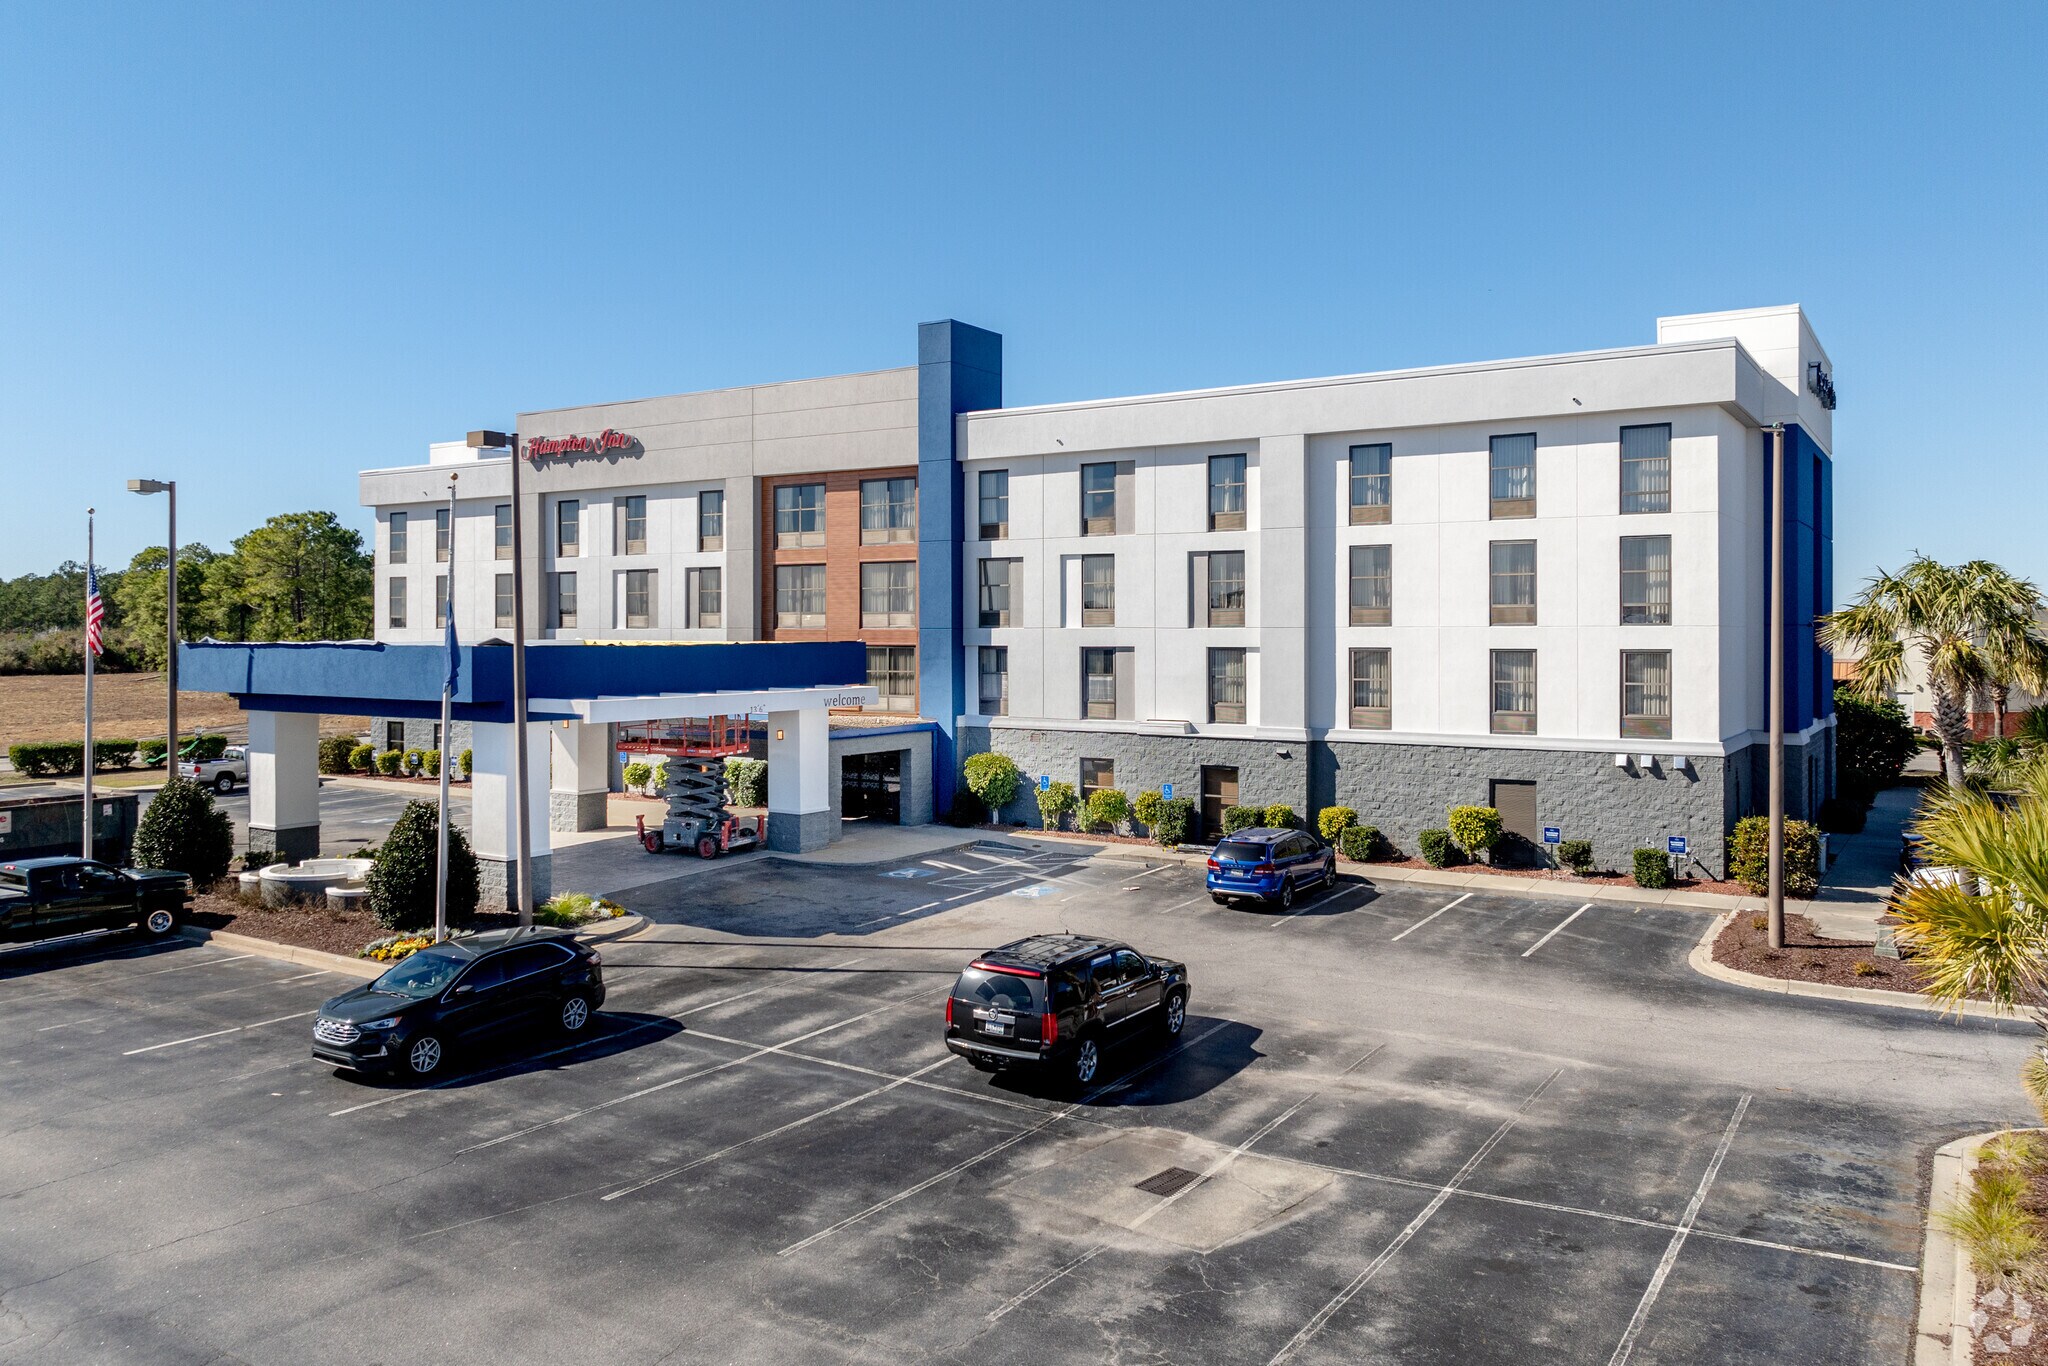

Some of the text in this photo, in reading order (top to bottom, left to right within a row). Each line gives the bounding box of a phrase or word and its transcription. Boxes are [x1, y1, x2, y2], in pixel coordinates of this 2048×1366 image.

[521, 428, 633, 460] Hampton Inn
[823, 694, 866, 706] welcome
